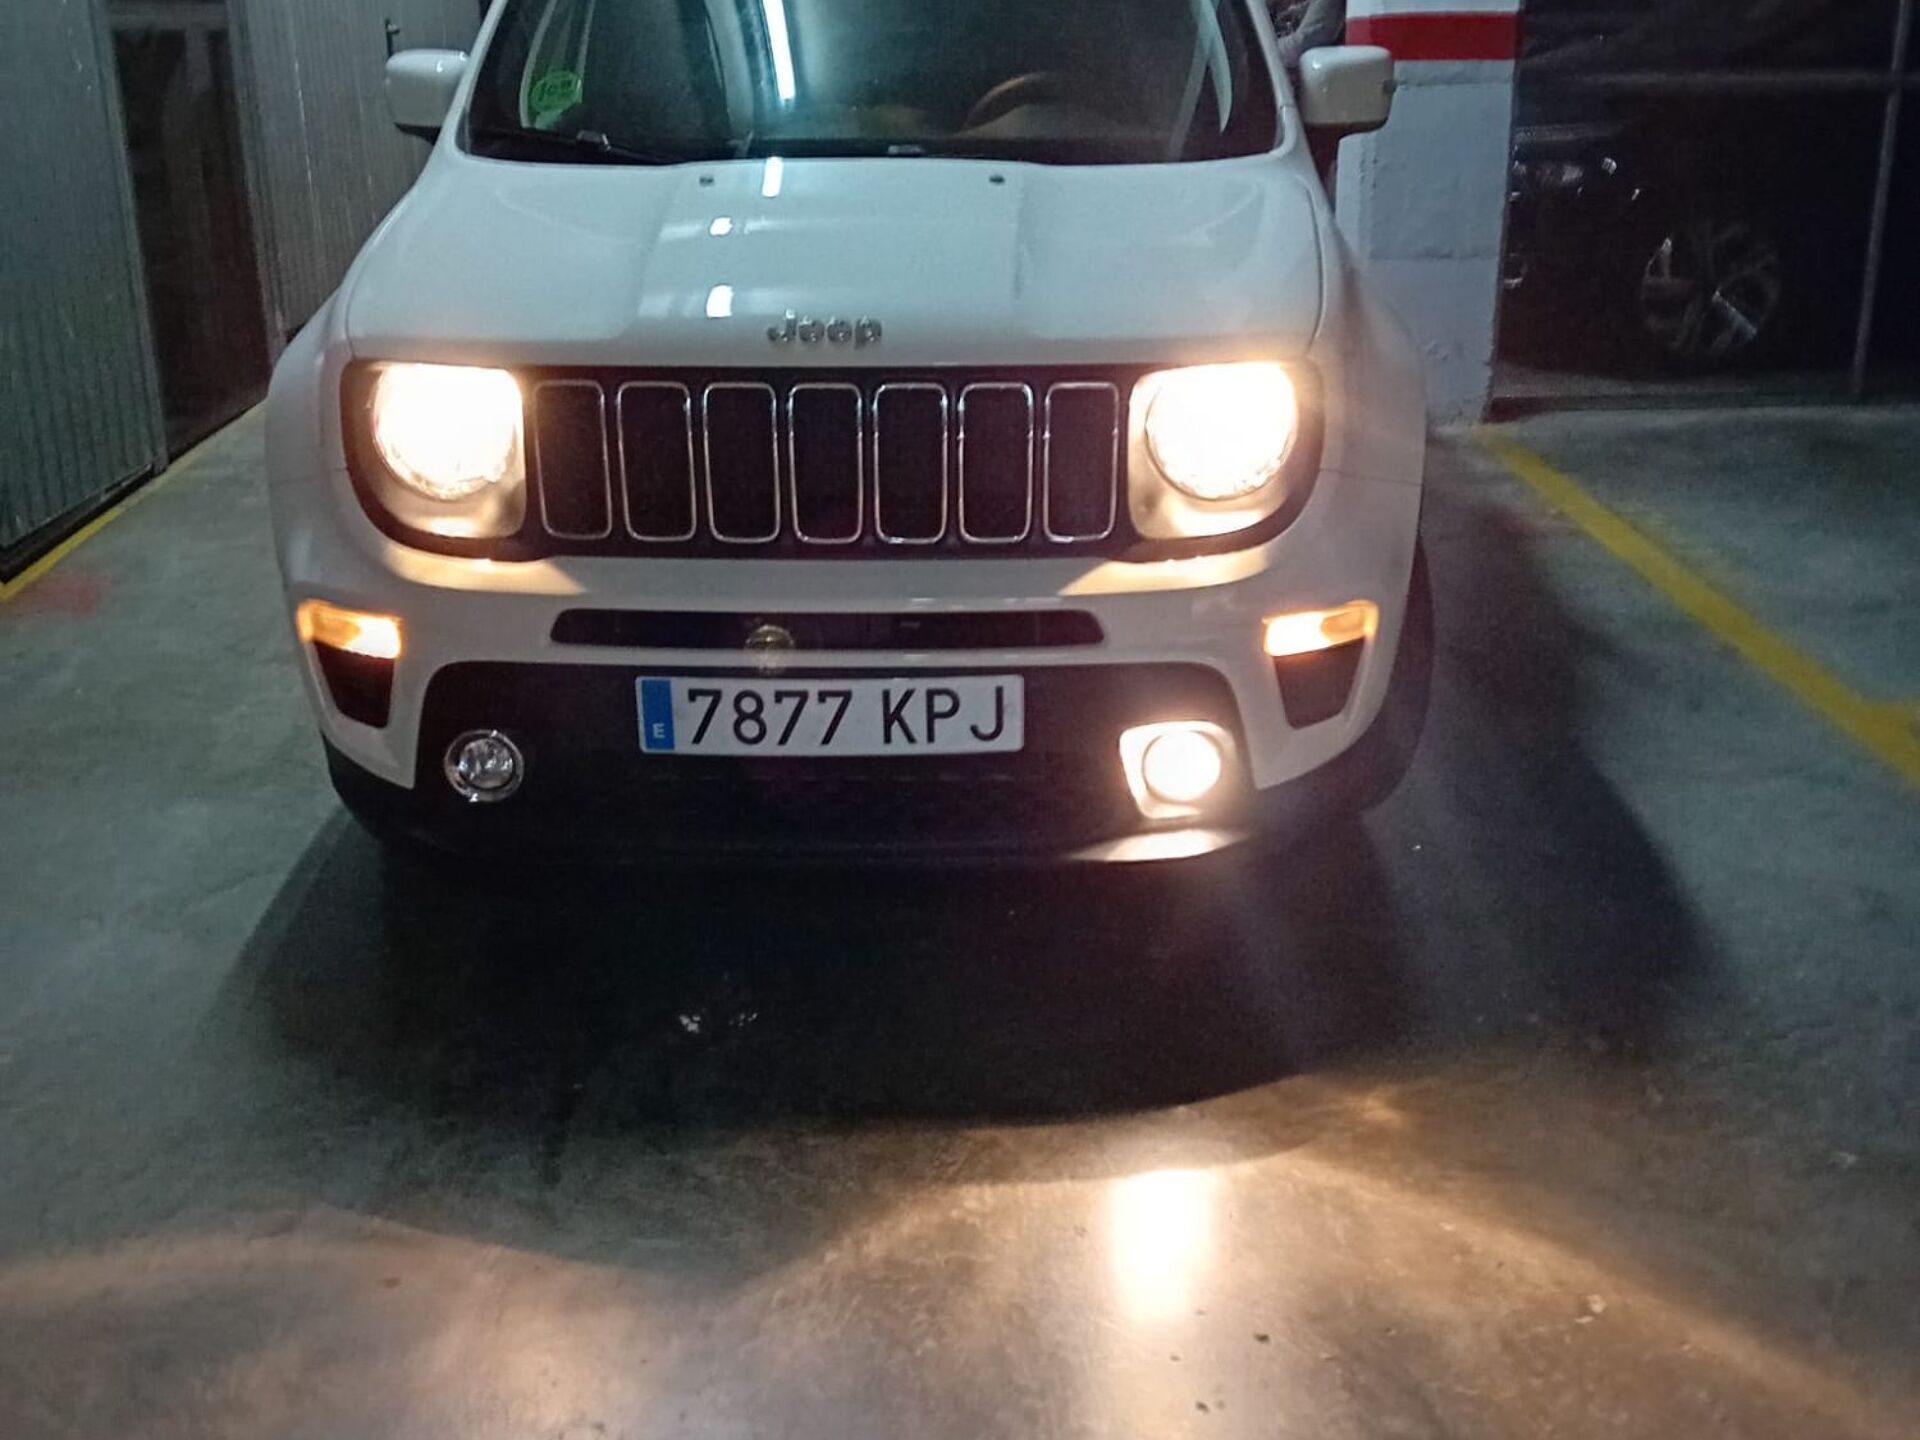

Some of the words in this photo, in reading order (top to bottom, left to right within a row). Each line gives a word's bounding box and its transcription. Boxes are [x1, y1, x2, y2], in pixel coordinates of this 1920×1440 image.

[766, 308, 882, 350] Jeep
[652, 723, 665, 738] E
[687, 688, 853, 745] 7877
[882, 686, 1004, 744] KPJ
